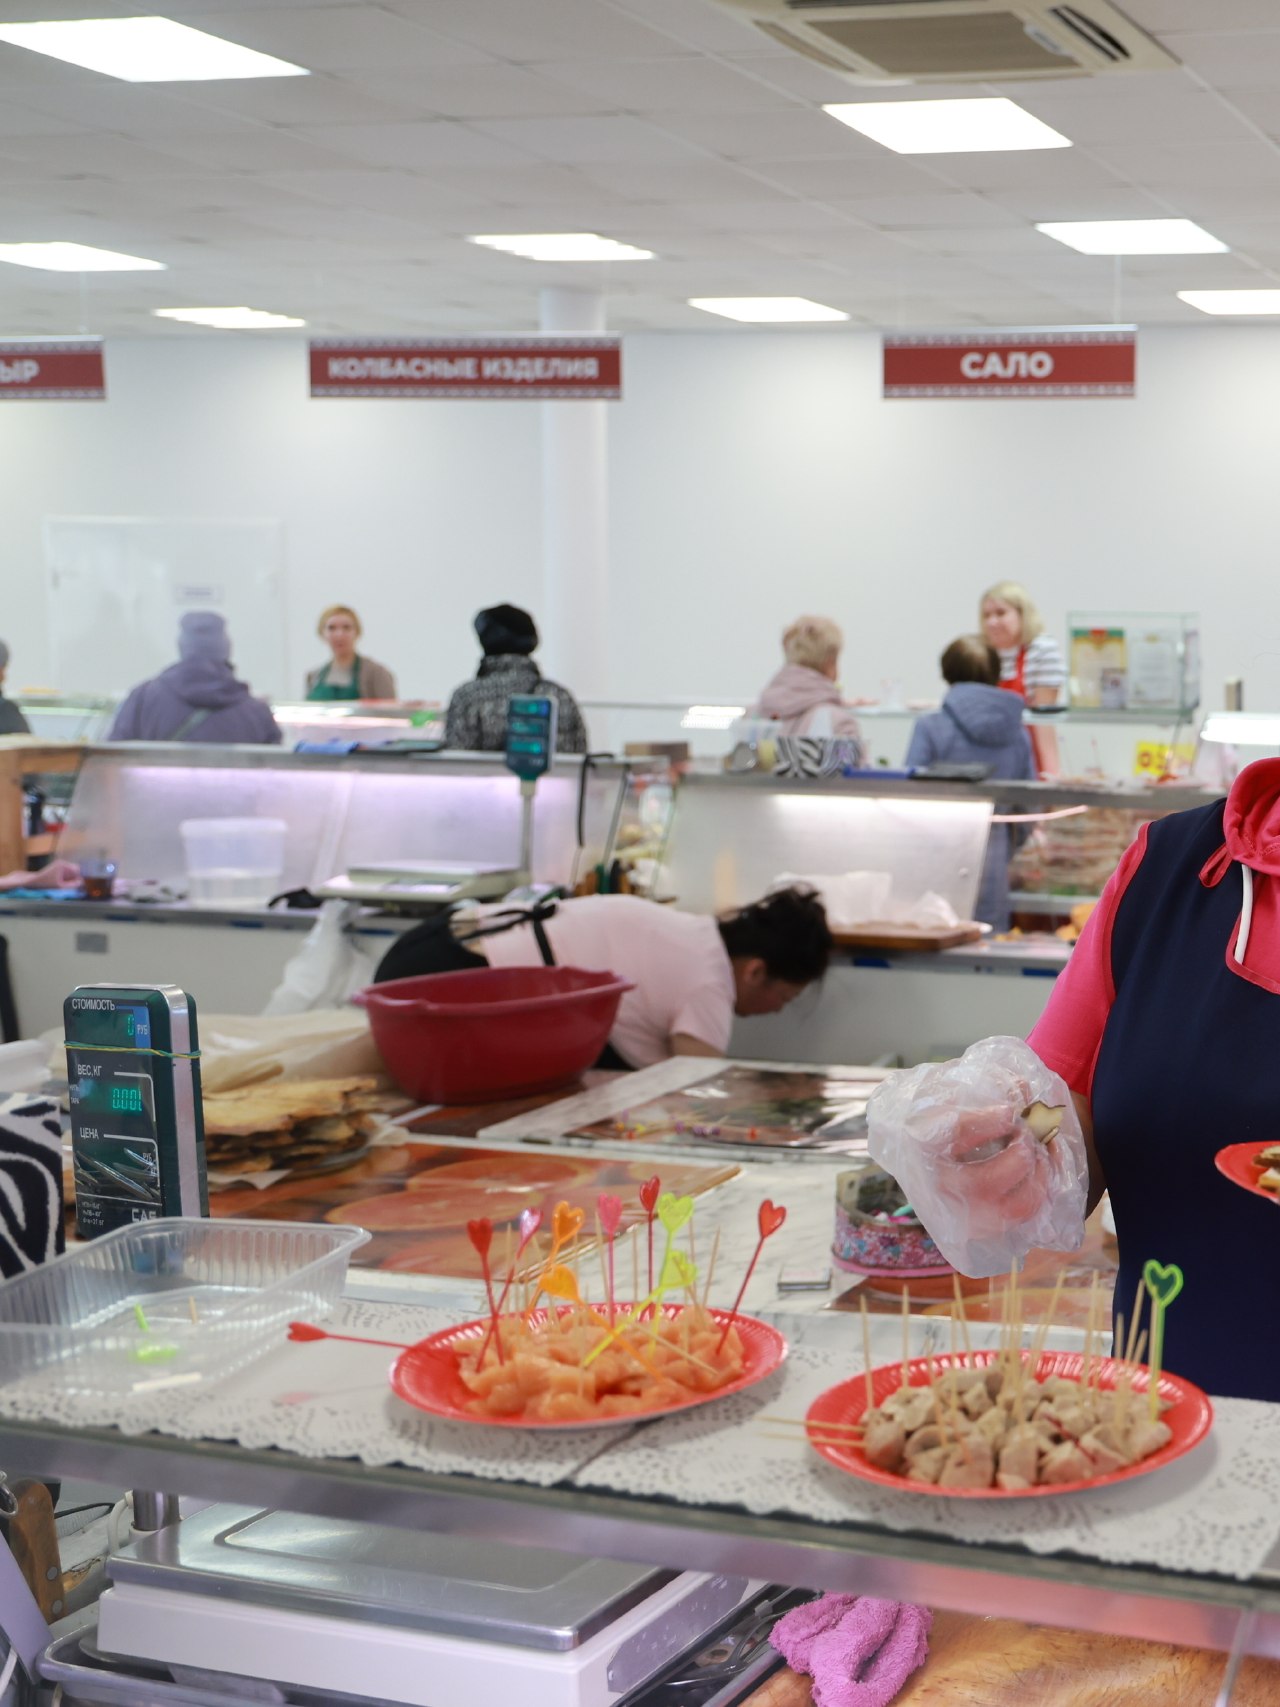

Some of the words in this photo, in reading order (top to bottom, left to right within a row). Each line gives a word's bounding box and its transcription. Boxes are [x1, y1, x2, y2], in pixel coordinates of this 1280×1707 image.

[327, 357, 479, 379] КОЛБАСНЫЕ
[482, 358, 600, 382] ИЗДЕЛИЯ
[960, 351, 1054, 378] САЛО
[71, 998, 116, 1011] СТОИМОСТЬ
[79, 1126, 99, 1140] ЦЕНА
